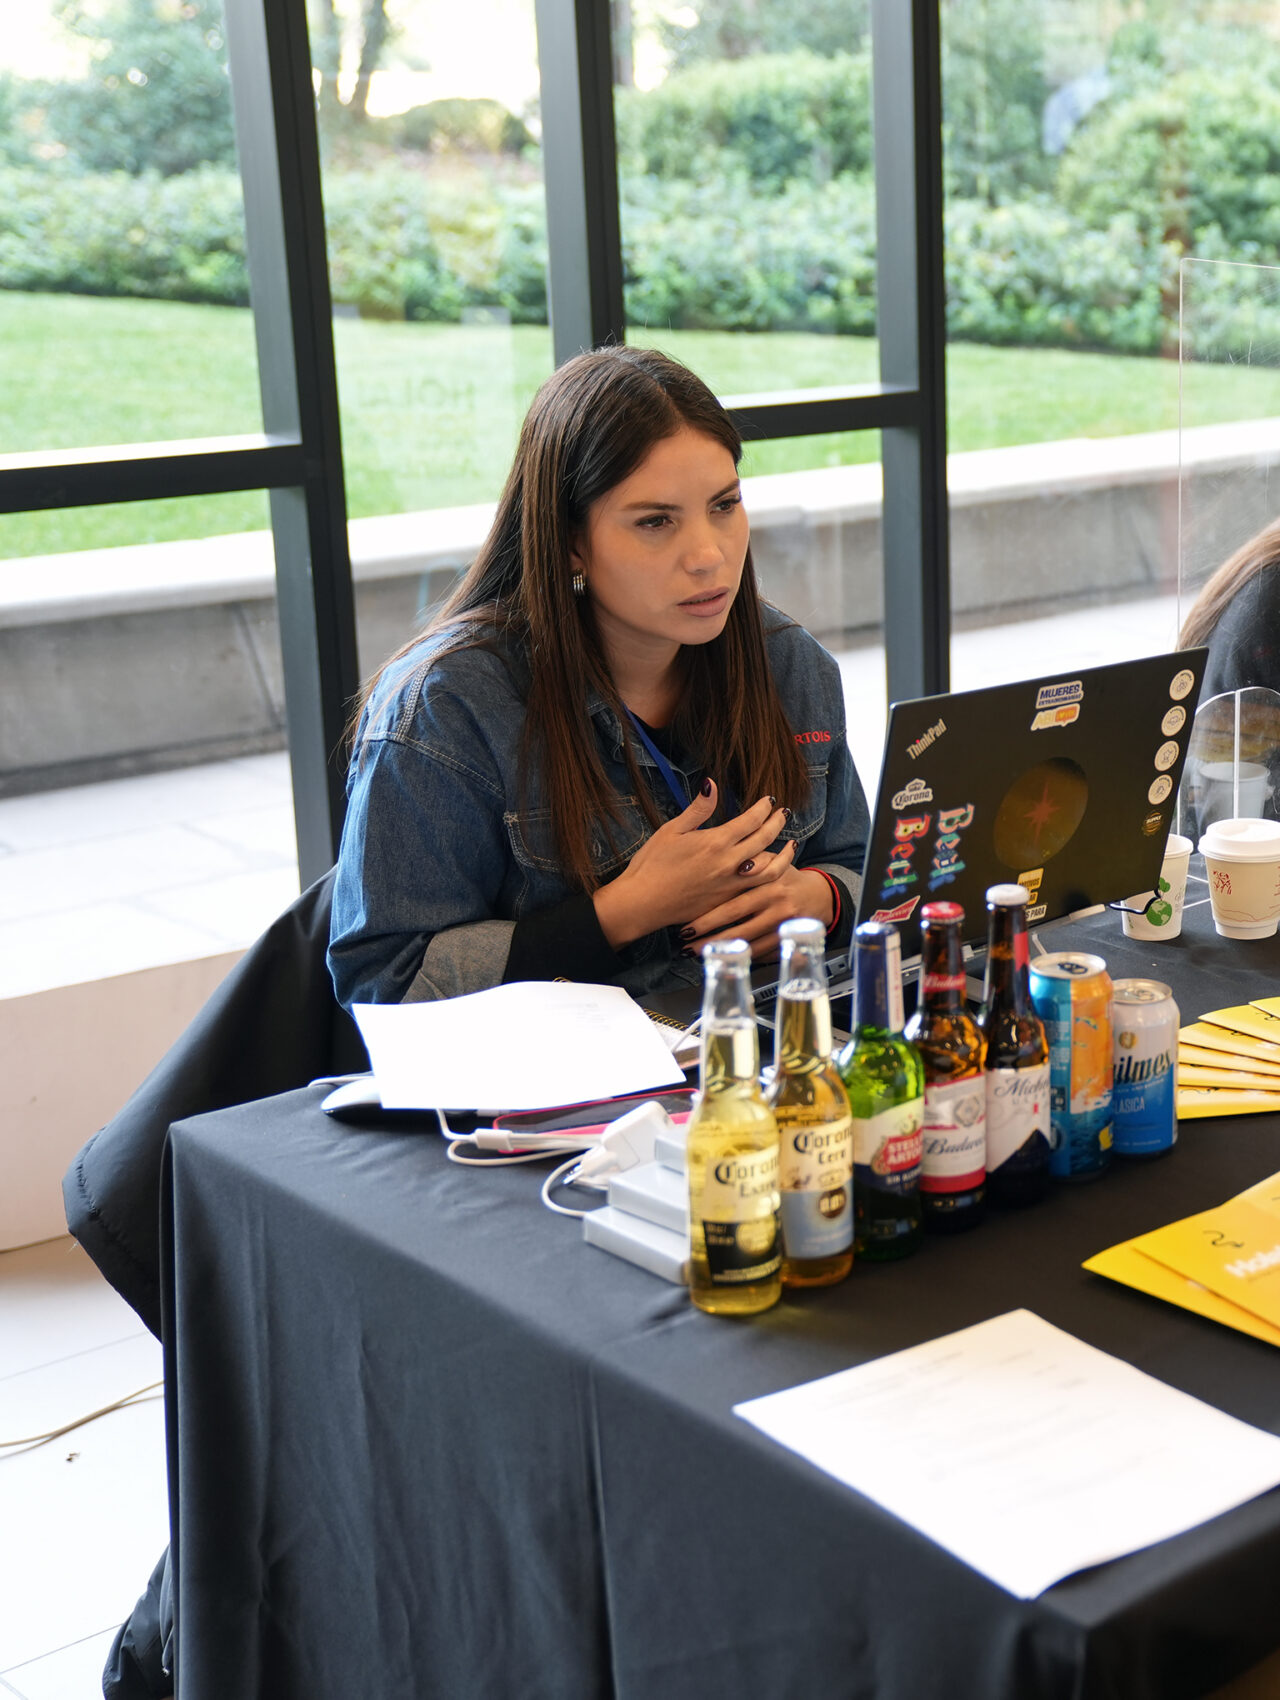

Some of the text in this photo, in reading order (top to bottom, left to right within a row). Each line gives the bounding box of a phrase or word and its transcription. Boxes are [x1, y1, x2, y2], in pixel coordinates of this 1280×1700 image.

[1040, 684, 1081, 700] MUJERES
[794, 730, 832, 745] RTOIS
[906, 718, 948, 760] ThinkPad
[894, 790, 931, 808] Corona
